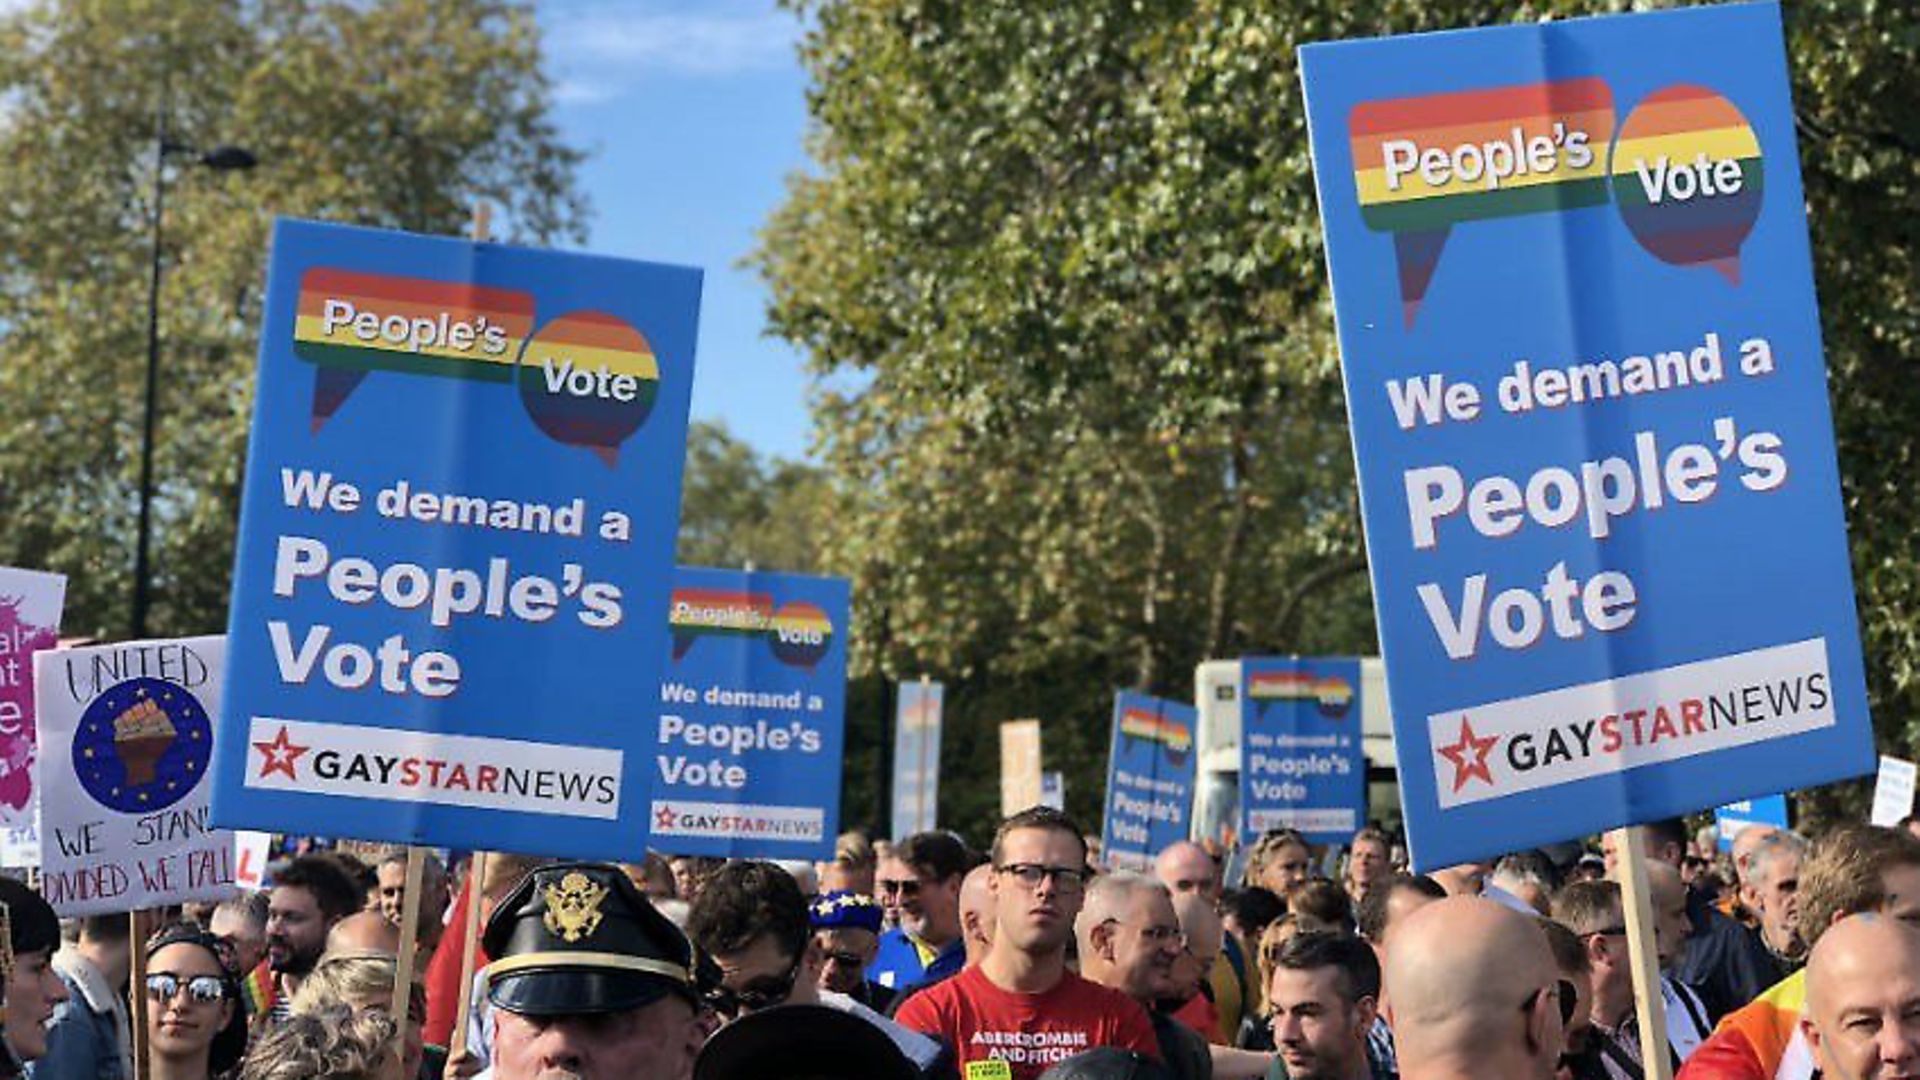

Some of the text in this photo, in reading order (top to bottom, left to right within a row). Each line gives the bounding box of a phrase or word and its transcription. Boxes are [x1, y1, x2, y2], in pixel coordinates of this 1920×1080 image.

[1382, 121, 1744, 205] People's Vote
[322, 298, 639, 403] People's Vote
[1385, 332, 1775, 431] We demand a
[281, 466, 631, 541] We demand a
[1403, 416, 1789, 551] People's
[273, 535, 624, 628] People's
[777, 625, 824, 645] Vote
[1416, 559, 1638, 662] Vote
[66, 644, 208, 703] UNITED
[267, 620, 462, 698] Vote
[661, 683, 823, 710] We demand a
[1506, 673, 1829, 773] GAYSTARNEWS
[658, 714, 822, 755] People's
[312, 749, 616, 805] GAYSTARNEWS
[657, 755, 747, 789] Vote
[1250, 753, 1350, 778] People's
[1251, 779, 1307, 800] Vote
[55, 821, 104, 857] WE
[681, 814, 821, 837] GAYSTARNEWS
[43, 847, 235, 905] DIVIDED WE FALL
[970, 1030, 1088, 1047] ABERCROMBIE
[988, 1046, 1074, 1064] AND FITCH
